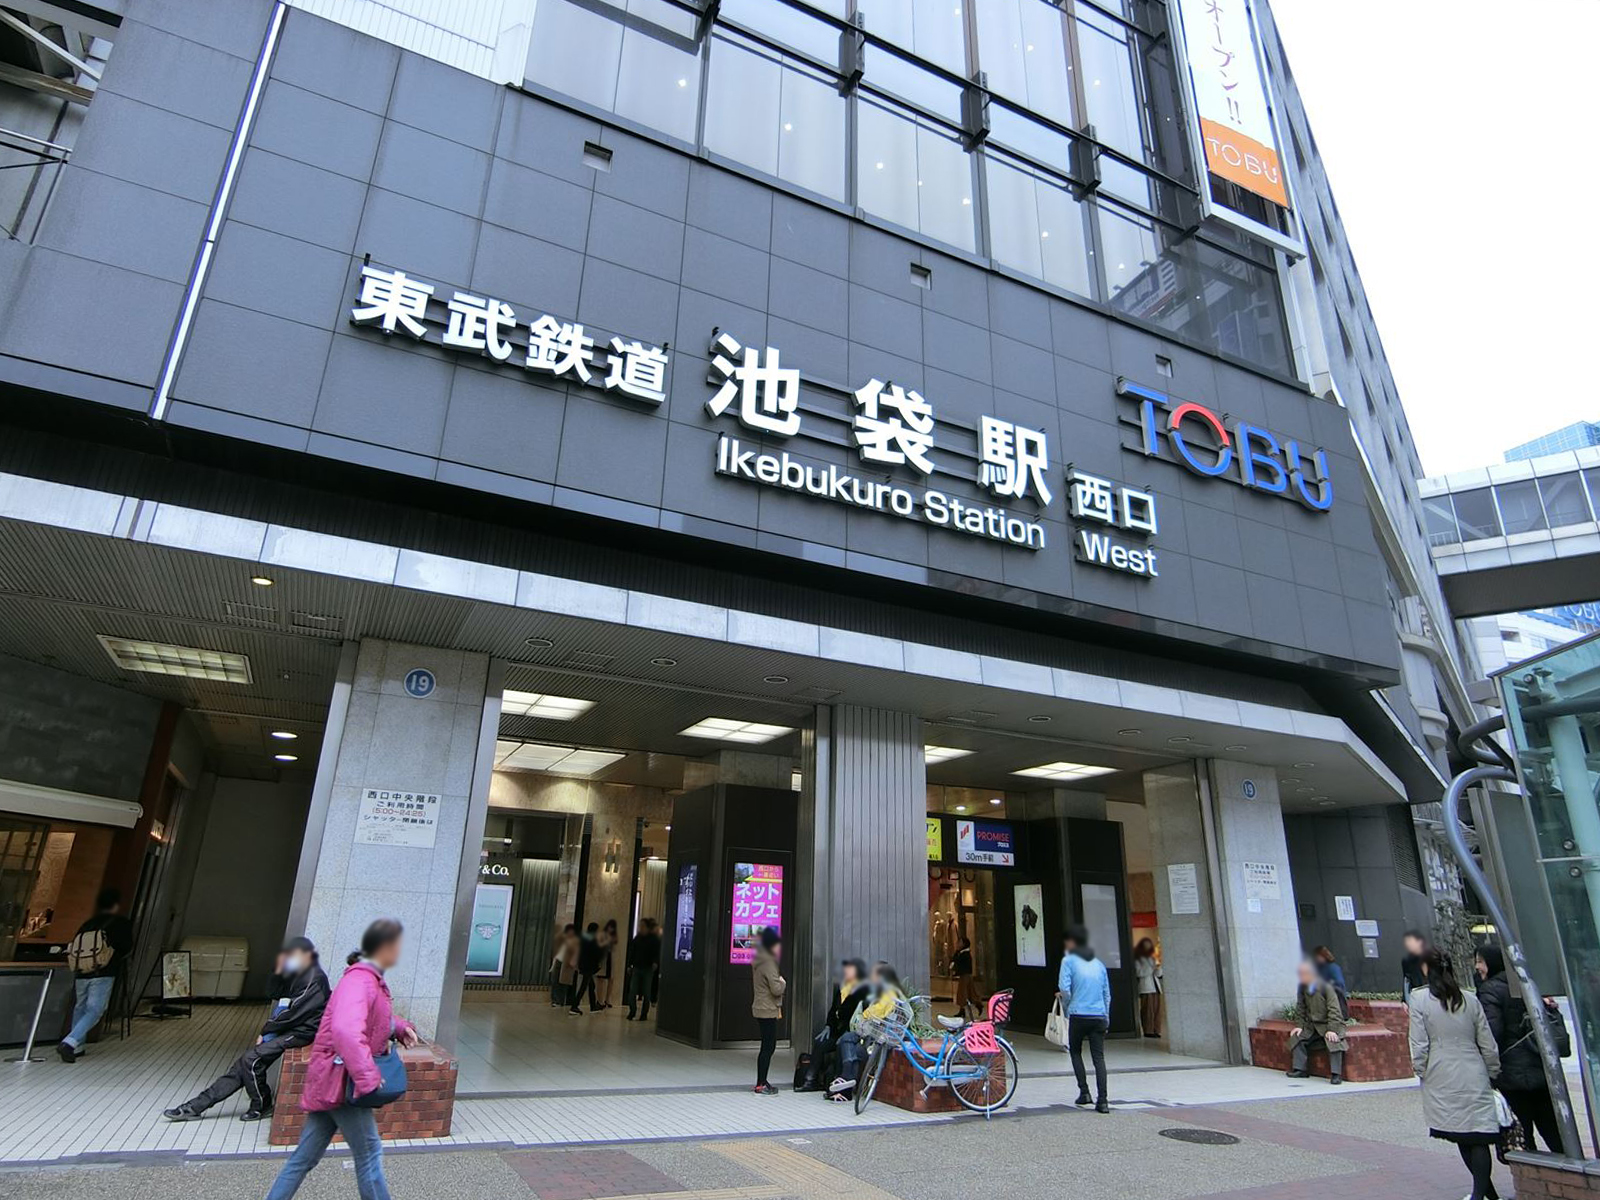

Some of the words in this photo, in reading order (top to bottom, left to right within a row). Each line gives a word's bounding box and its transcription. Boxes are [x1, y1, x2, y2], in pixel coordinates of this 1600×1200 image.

[1206, 137, 1278, 184] TOBU
[351, 265, 669, 405] 東武鉄道
[704, 332, 1052, 509] 池袋駅
[1070, 472, 1158, 535] 西口
[1117, 382, 1333, 512] TOBU
[715, 436, 913, 516] Ikebukuro
[924, 490, 1046, 549] Station
[1080, 530, 1159, 577] West
[410, 674, 430, 692] 19
[367, 790, 438, 804] 西口中央階段
[376, 800, 425, 810] ご利用時間
[976, 831, 1011, 842] PROMISE
[482, 864, 491, 875] &
[736, 881, 780, 900] ネット
[735, 900, 779, 918] カフェ
